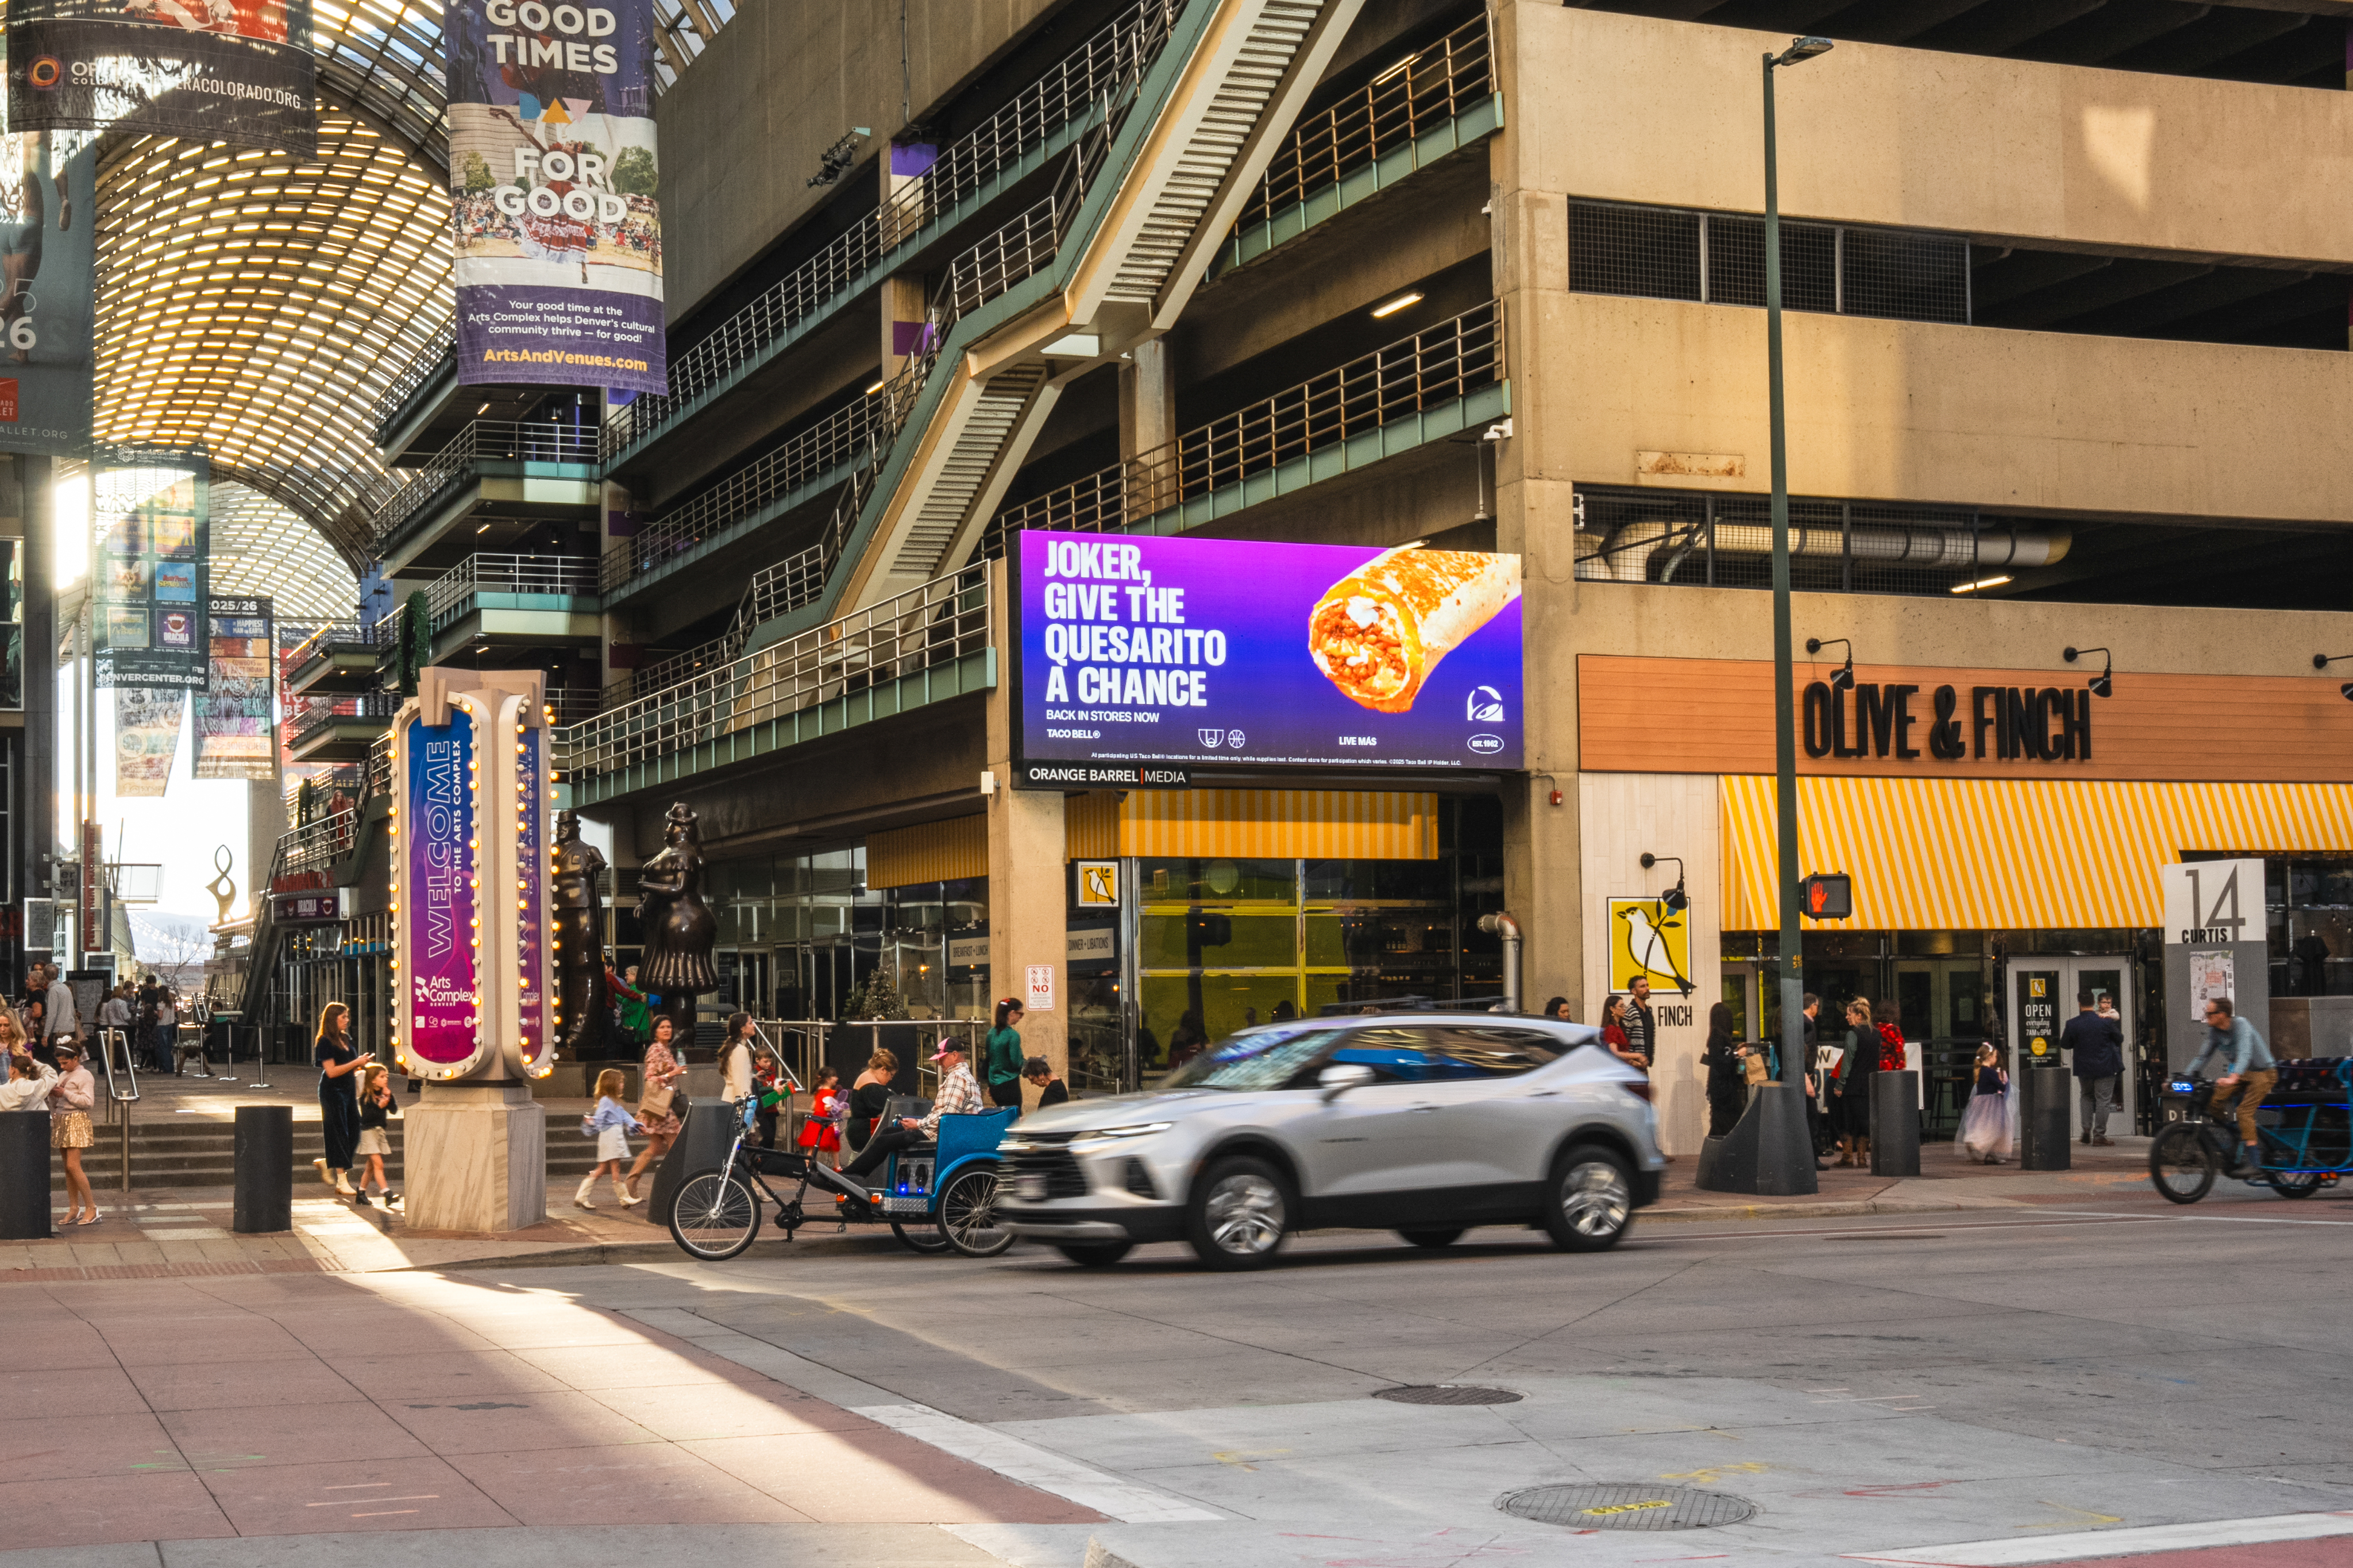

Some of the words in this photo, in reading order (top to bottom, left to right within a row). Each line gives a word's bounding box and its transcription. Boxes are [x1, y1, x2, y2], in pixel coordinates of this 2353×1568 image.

[486, 0, 616, 37] GOOD
[487, 34, 618, 74] TIMES
[175, 78, 301, 110] ERACOLORADO.ORG
[514, 147, 605, 185] FOR
[495, 185, 627, 223] GOOD
[509, 300, 533, 310] Your
[537, 302, 564, 312] good
[567, 302, 591, 313] time
[593, 305, 603, 314] at
[606, 306, 623, 316] the
[468, 312, 490, 322] Arts
[493, 312, 541, 323] Complex
[543, 313, 572, 325] helps
[575, 315, 618, 328] Denver's
[621, 320, 655, 334] cultural
[488, 325, 548, 337] community
[551, 326, 581, 337] thrive
[596, 329, 611, 339] for
[614, 332, 642, 343] good!
[484, 349, 648, 372] ArtsAndVenues.com
[1044, 540, 1151, 588] JOKER,
[1044, 582, 1118, 620] GIVE
[1125, 586, 1185, 624] THE
[237, 620, 263, 628] HAPPIEST
[164, 632, 189, 642] DRACULA
[1045, 623, 1226, 666] QUESARITO
[1046, 666, 1069, 702] A
[1078, 666, 1207, 706] CHANCE
[284, 705, 302, 716] BE
[1046, 709, 1076, 720] BACK
[1078, 710, 1089, 721] IN
[1090, 710, 1132, 722] STORES
[1134, 712, 1159, 723] NOW
[1804, 681, 1920, 758] OLIVE
[1930, 685, 1966, 760] &
[1973, 686, 2091, 761] FINCH
[1047, 729, 1071, 738] TACO
[1338, 736, 1356, 746] LIVE
[1358, 735, 1377, 746] MÁS
[452, 740, 461, 805] COMPLEX
[1029, 768, 1086, 782] ORANGE
[1090, 770, 1139, 782] BARREL
[1145, 771, 1186, 783] MEDIA
[453, 810, 462, 842] ARTS
[427, 740, 452, 958] WELCOME
[453, 847, 462, 871] THE
[453, 875, 462, 894] TO
[527, 882, 534, 897] TO
[2185, 863, 2246, 942] 14
[1068, 939, 1083, 951] DINNER
[1087, 937, 1109, 949] LIBATIONS
[2182, 928, 2227, 944] CURTIS
[953, 946, 973, 957] BREAKFAST
[976, 945, 988, 956] LUNCH
[430, 975, 451, 988] Arts
[1032, 984, 1048, 992] NO
[430, 987, 474, 1006] Complex
[1658, 1005, 1692, 1026] FINCH
[2026, 1005, 2051, 1017] OPEN
[2026, 1018, 2050, 1029] everyday
